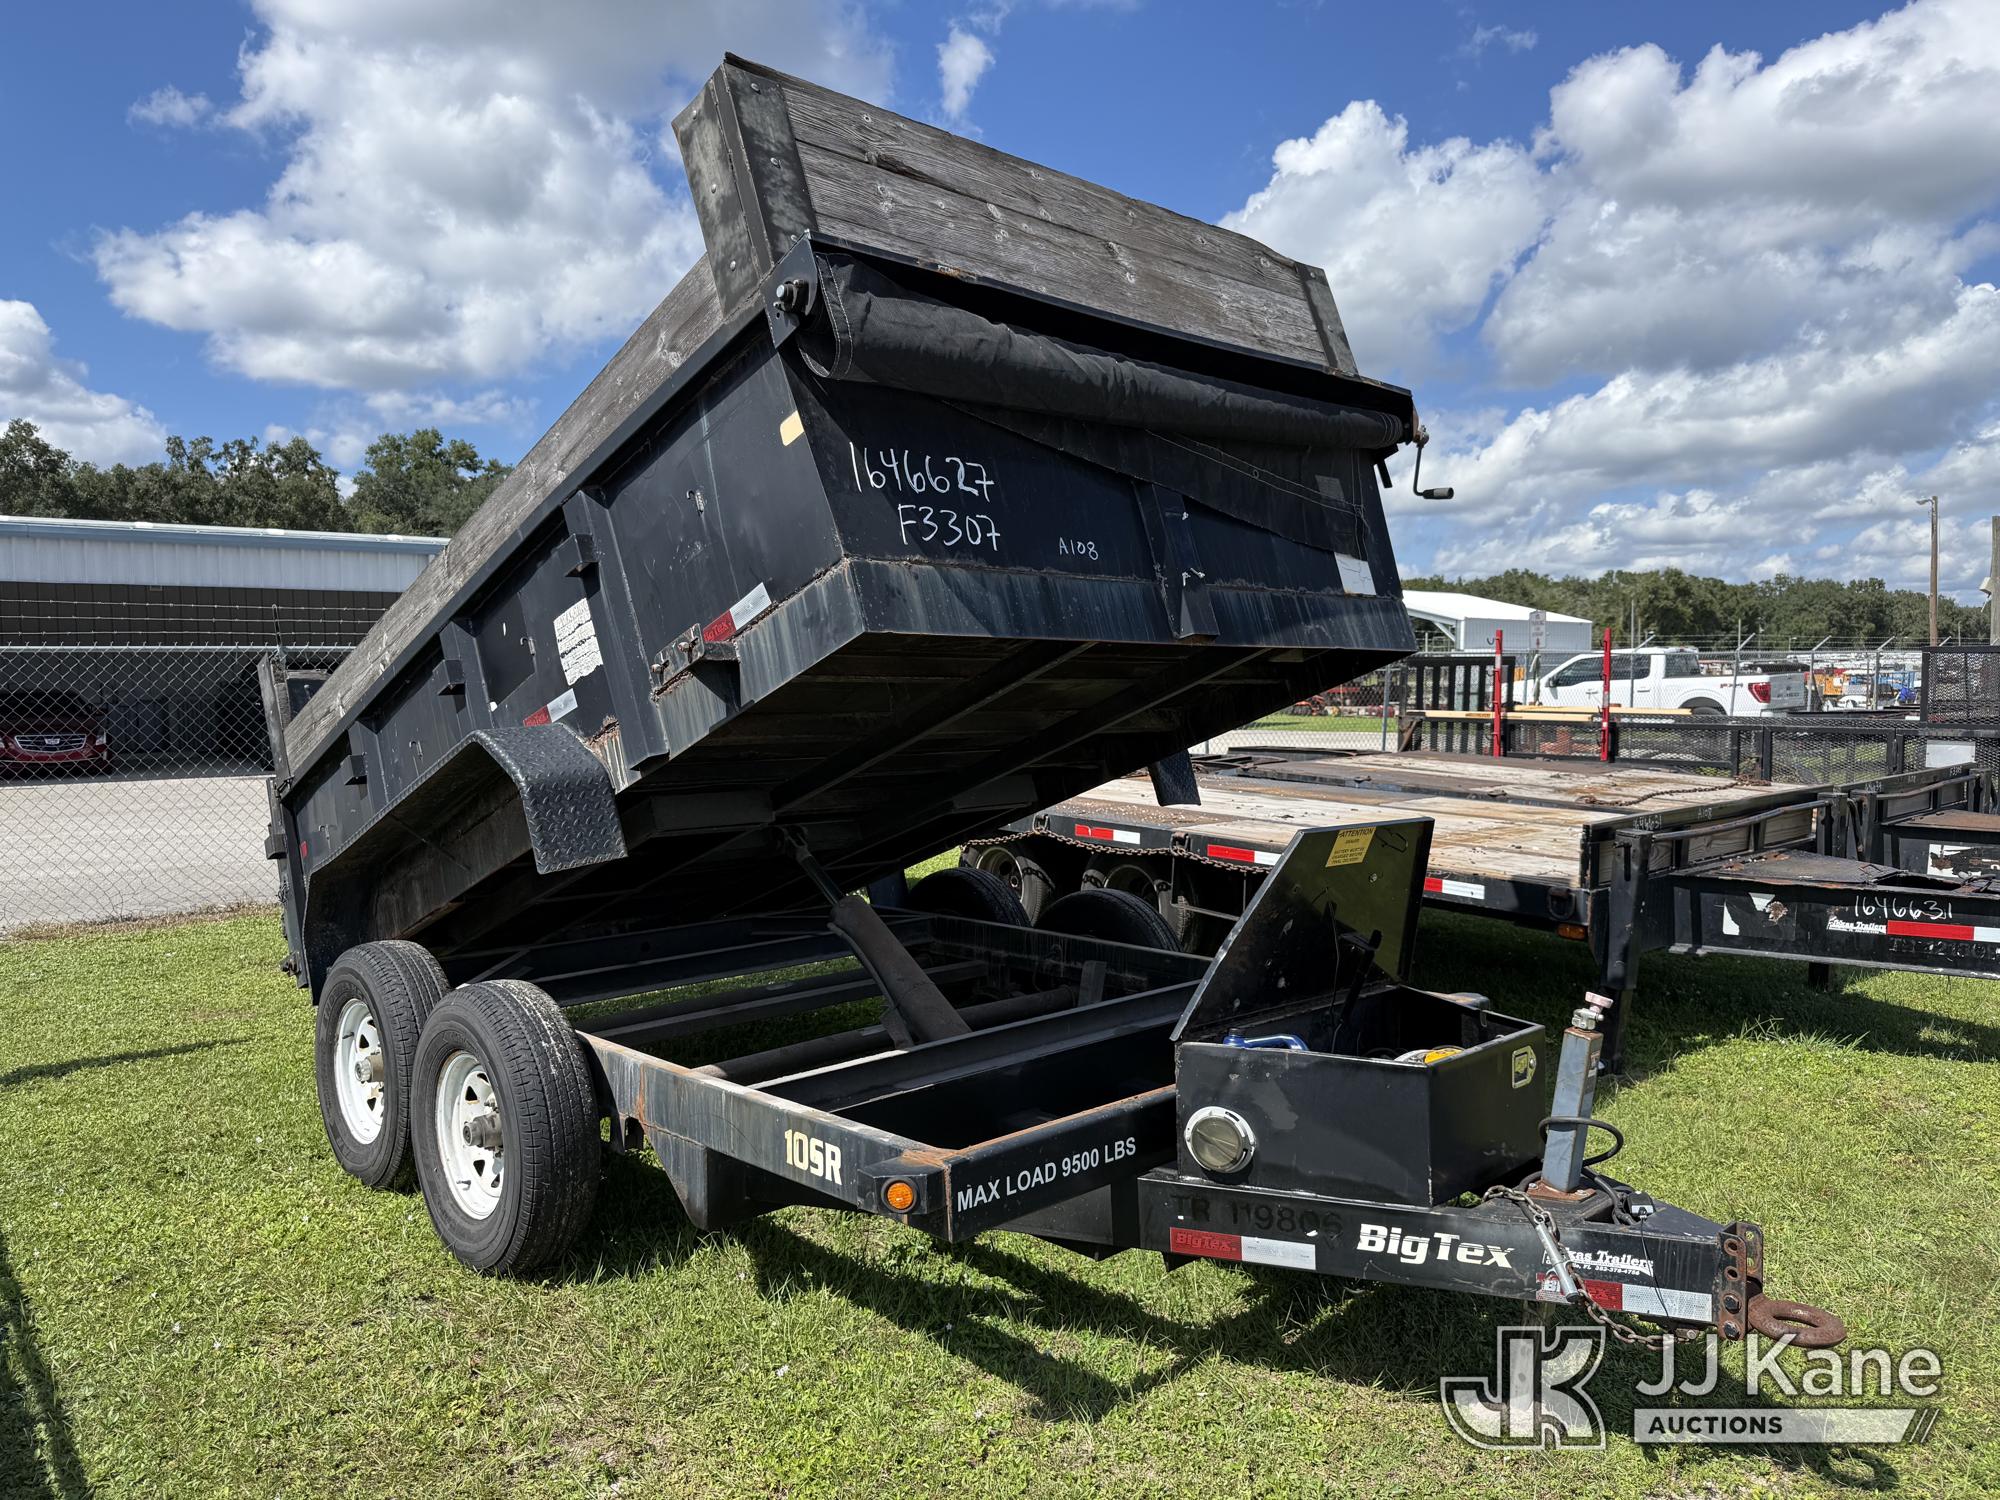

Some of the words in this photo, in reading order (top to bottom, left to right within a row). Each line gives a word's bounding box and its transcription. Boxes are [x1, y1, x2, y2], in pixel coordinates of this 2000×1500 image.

[849, 441, 995, 502] 1646627
[898, 503, 1001, 551] F3307
[1059, 537, 1099, 560] A108
[1339, 827, 1373, 838] ATTENTION
[1854, 896, 1953, 920] 1646631
[783, 1128, 843, 1186] 10SR
[957, 1179, 1001, 1212] MAX
[1005, 1162, 1057, 1197] LOAD
[1061, 1148, 1100, 1178] 9500
[1104, 1136, 1137, 1164] LBS
[1356, 1223, 1515, 1269] BigTex
